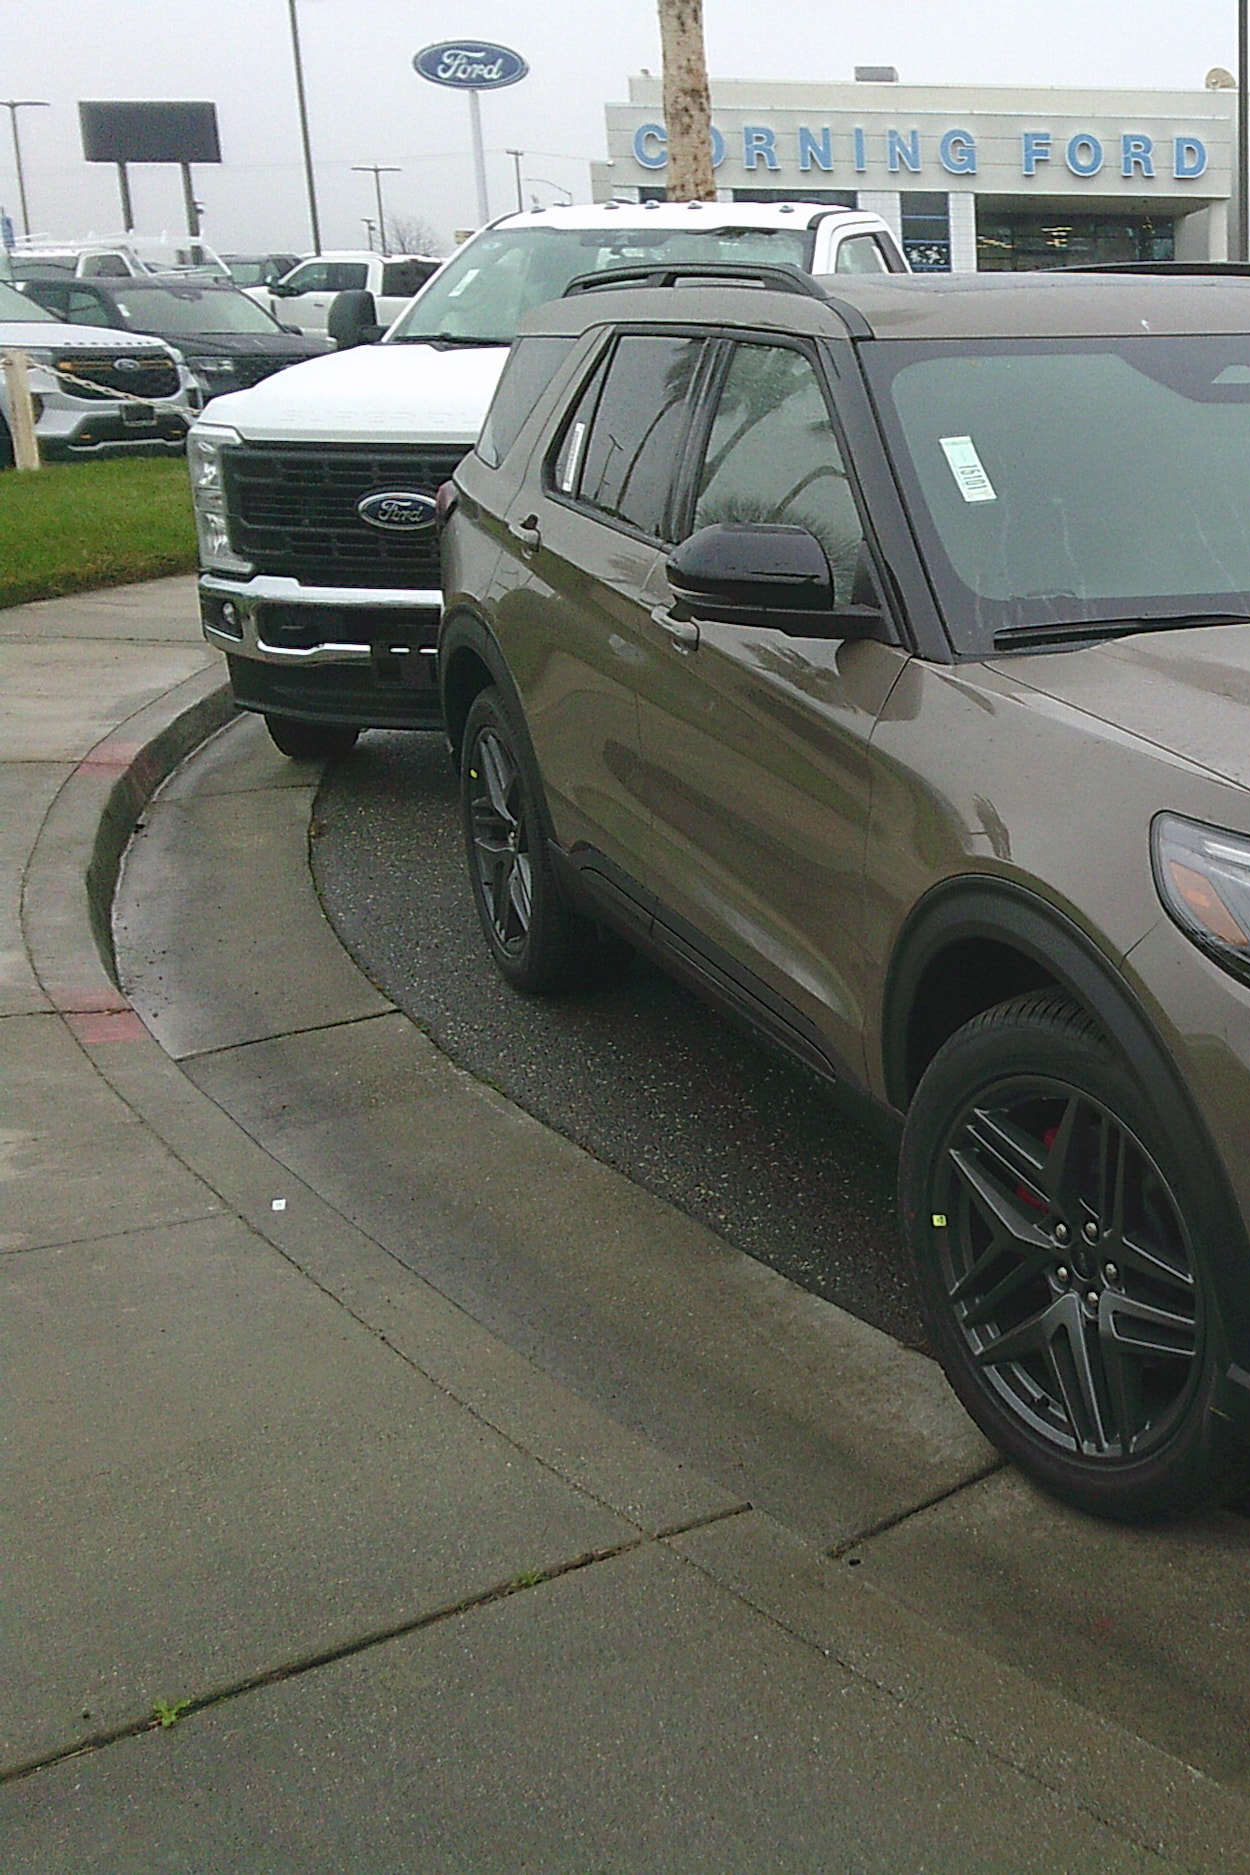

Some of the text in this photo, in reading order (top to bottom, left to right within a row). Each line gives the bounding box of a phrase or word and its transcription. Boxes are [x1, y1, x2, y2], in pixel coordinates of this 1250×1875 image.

[437, 50, 503, 79] Ford
[1022, 132, 1209, 179] FORD
[378, 500, 424, 521] Ford
